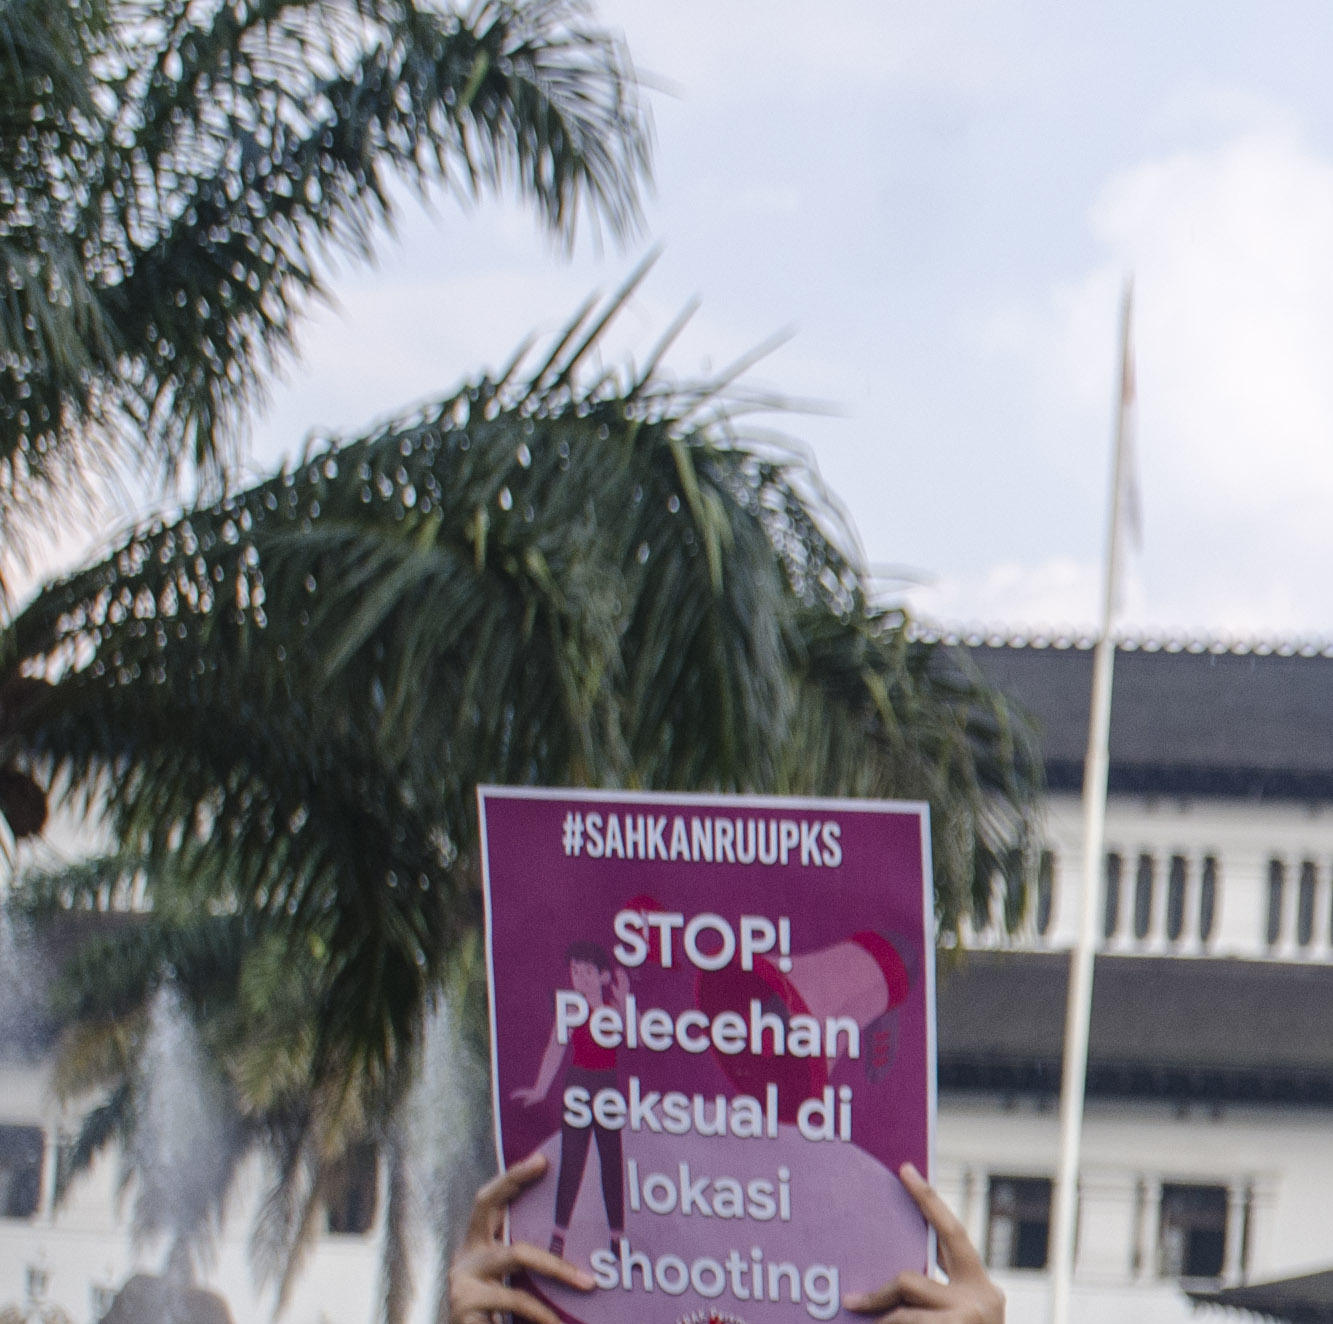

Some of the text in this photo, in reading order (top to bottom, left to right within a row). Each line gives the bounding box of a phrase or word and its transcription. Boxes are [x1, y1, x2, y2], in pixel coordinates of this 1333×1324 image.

[563, 812, 843, 867] #SAHKANRUUPKS
[614, 911, 793, 973] STOP!
[555, 990, 861, 1059] Pelecehan
[563, 1077, 853, 1142] seksual di
[628, 1161, 791, 1221] lokasi
[590, 1247, 841, 1320] shooting
